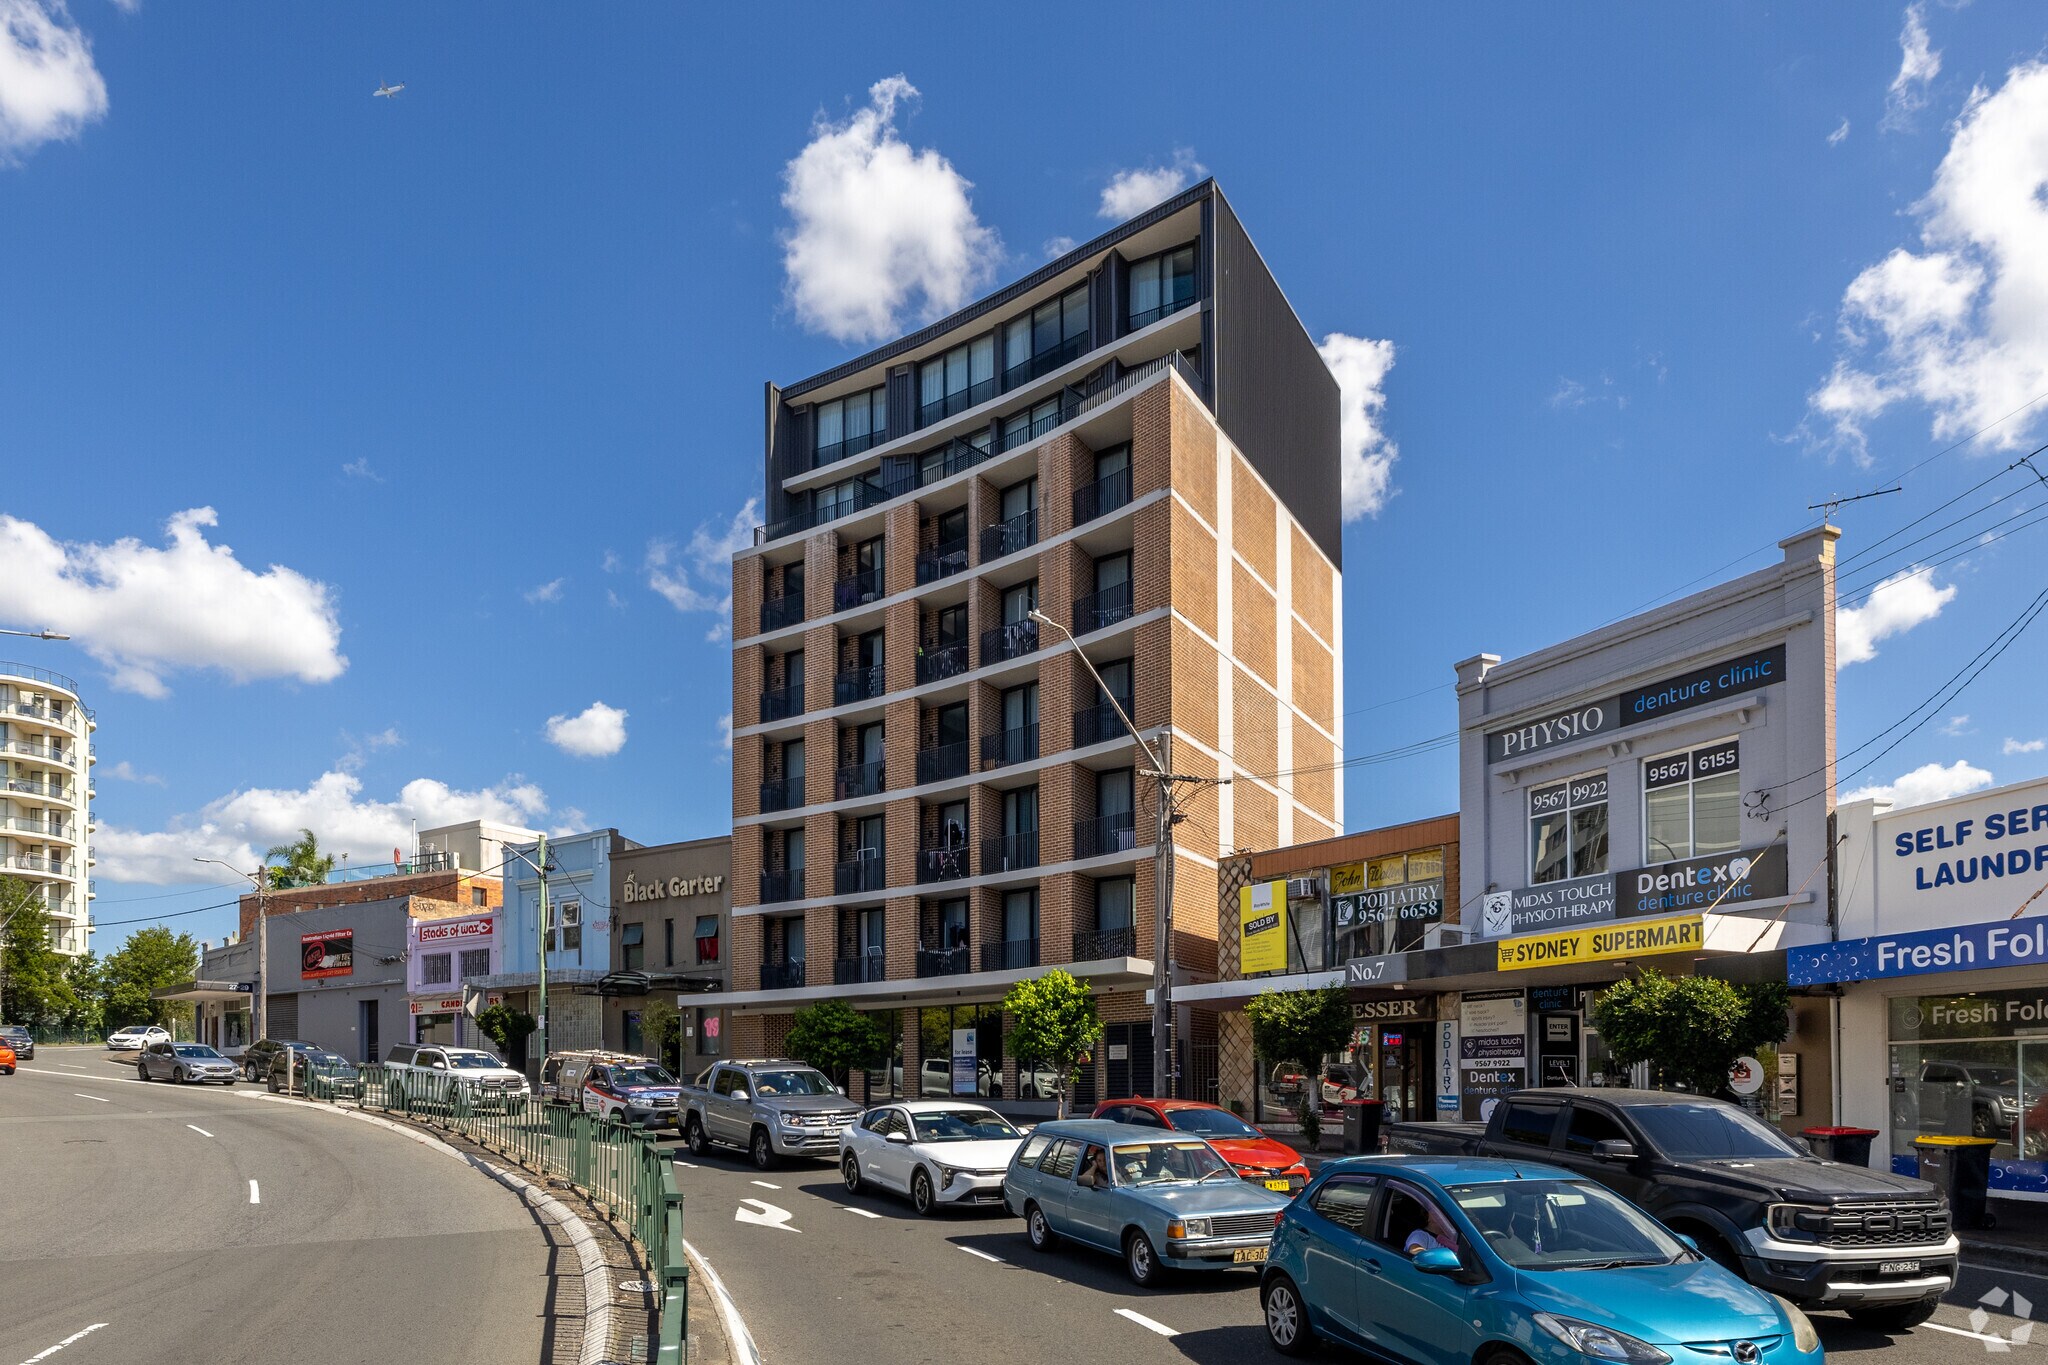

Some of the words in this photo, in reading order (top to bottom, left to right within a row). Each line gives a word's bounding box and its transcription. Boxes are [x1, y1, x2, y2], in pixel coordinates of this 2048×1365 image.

[1634, 679, 1711, 713] denture
[1718, 658, 1772, 689] clinic
[1502, 707, 1604, 757] PHYSIO
[1649, 761, 1688, 782] 9567
[1699, 749, 1736, 771] 6155
[1534, 789, 1566, 811] 9567
[1573, 780, 1607, 803] 9922
[1895, 819, 1973, 857] SELF
[623, 879, 666, 903] Black
[668, 874, 724, 897] Garter
[1638, 864, 1727, 894] Dentex
[1359, 884, 1439, 909] PODIATRY
[1514, 891, 1553, 909] MIDAS
[1558, 882, 1612, 901] TOUCH
[1638, 891, 1703, 911] denture
[1707, 881, 1752, 901] clinic
[1248, 918, 1266, 930] SOLD
[1265, 915, 1275, 924] BY
[1359, 906, 1395, 924] 9567
[1400, 900, 1438, 919] 6658
[1512, 899, 1615, 926] PHYSIOTHERAPY
[423, 926, 448, 940] stacks
[450, 924, 459, 938] of
[461, 924, 479, 935] wax
[1516, 937, 1580, 962] SYDNEY
[1592, 922, 1703, 954] SUPERMART
[1877, 933, 1975, 972] Fresh
[1987, 923, 2048, 961] Fol
[1350, 962, 1385, 981] No.7
[1532, 987, 1568, 998] denture
[1539, 999, 1562, 1009] clinic
[1351, 1000, 1418, 1019] ESSER
[1932, 1003, 1997, 1025] Fresh
[1478, 1038, 1499, 1046] midas
[1500, 1036, 1522, 1045] touch
[1478, 1047, 1522, 1057] physiotherapy
[1443, 1023, 1451, 1094] PODIATRY
[1493, 1059, 1511, 1067] 9922
[1470, 1071, 1515, 1083] Dentex
[1464, 1086, 1498, 1095] denture
[1830, 1214, 1948, 1232] FORD
